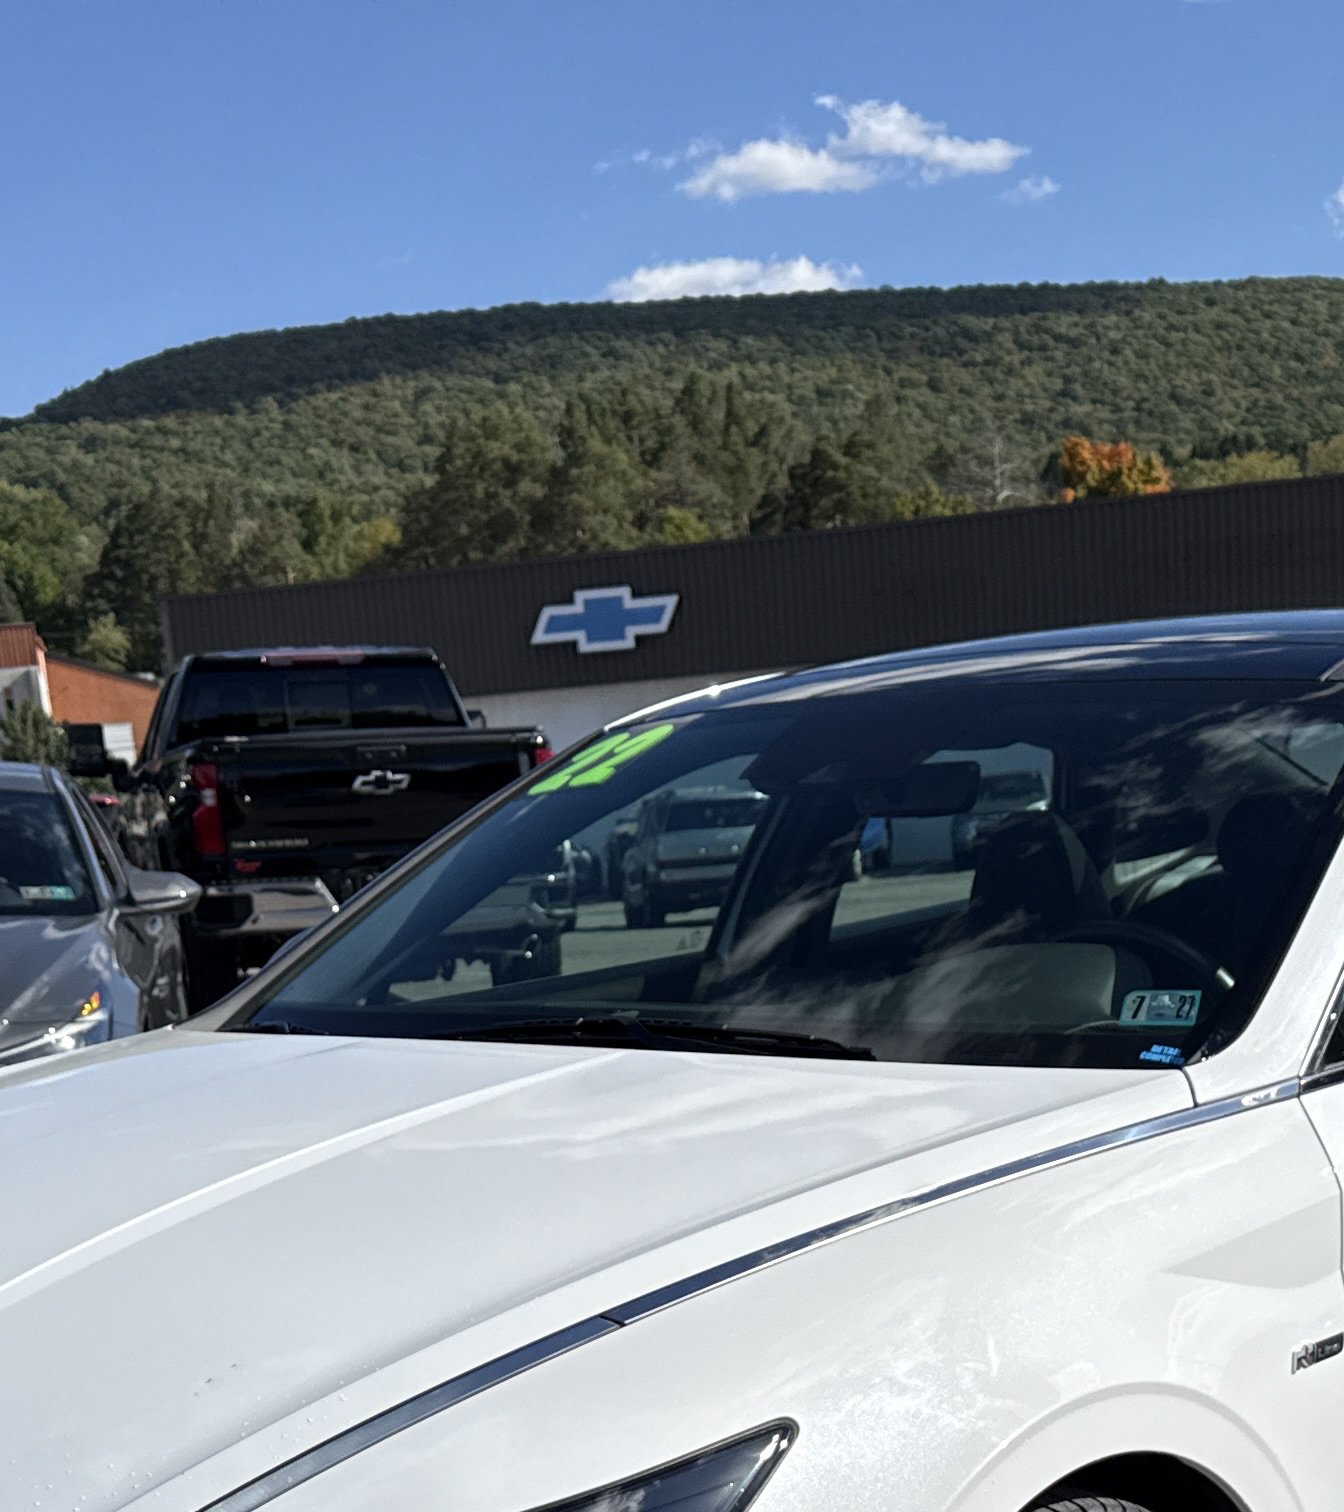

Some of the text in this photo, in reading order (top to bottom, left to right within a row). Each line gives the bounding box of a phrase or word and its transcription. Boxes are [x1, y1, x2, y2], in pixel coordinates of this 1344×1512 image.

[527, 723, 675, 796] 22
[1131, 995, 1196, 1021] 7 27
